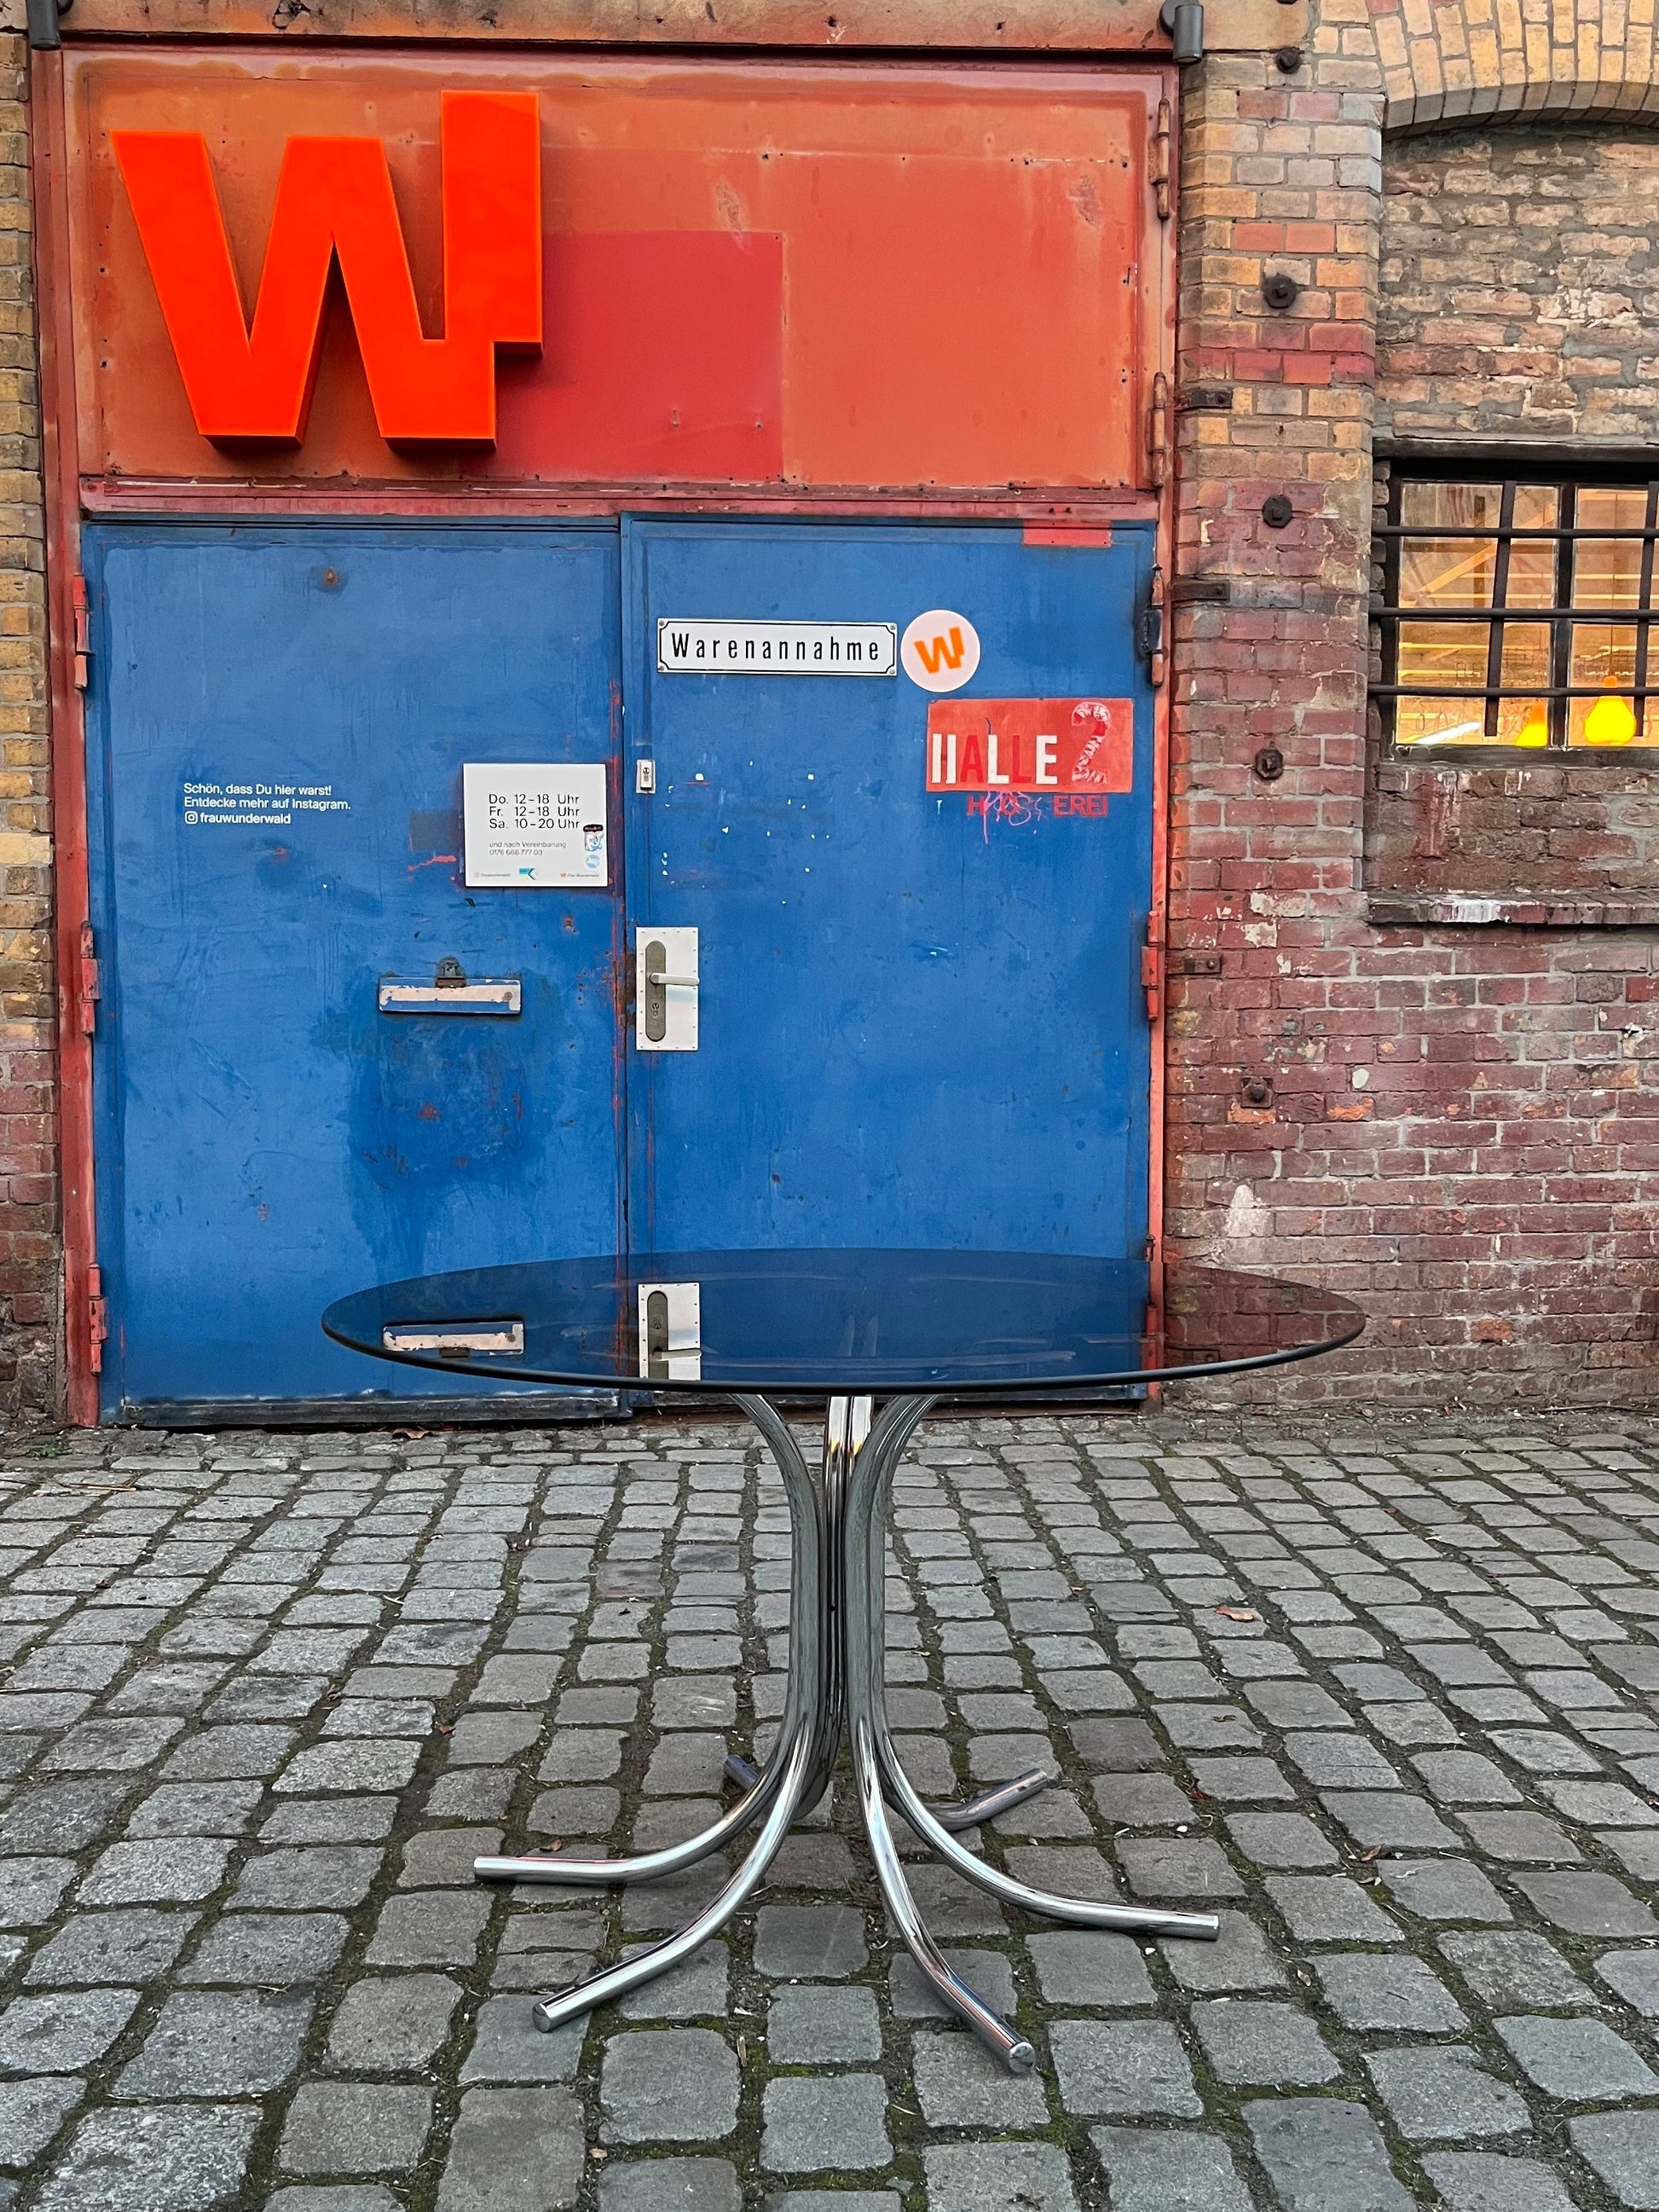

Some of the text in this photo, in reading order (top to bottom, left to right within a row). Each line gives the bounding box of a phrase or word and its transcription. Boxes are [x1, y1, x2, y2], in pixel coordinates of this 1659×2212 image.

[670, 633, 880, 661] Warenannahme
[931, 702, 1112, 785] HALLE 2
[183, 782, 332, 796] Schön, dass Du hier warst!
[184, 796, 351, 811] Entdecke mehr auf Instagram.
[488, 793, 509, 804] Do.
[558, 793, 580, 804] Uhr
[489, 806, 503, 817] Fr.
[558, 806, 580, 817] Uhr
[199, 812, 292, 825] frauwunderwald
[488, 818, 509, 829] Sa.
[558, 818, 580, 829] Uhr
[521, 841, 567, 849] Vereinbarung
